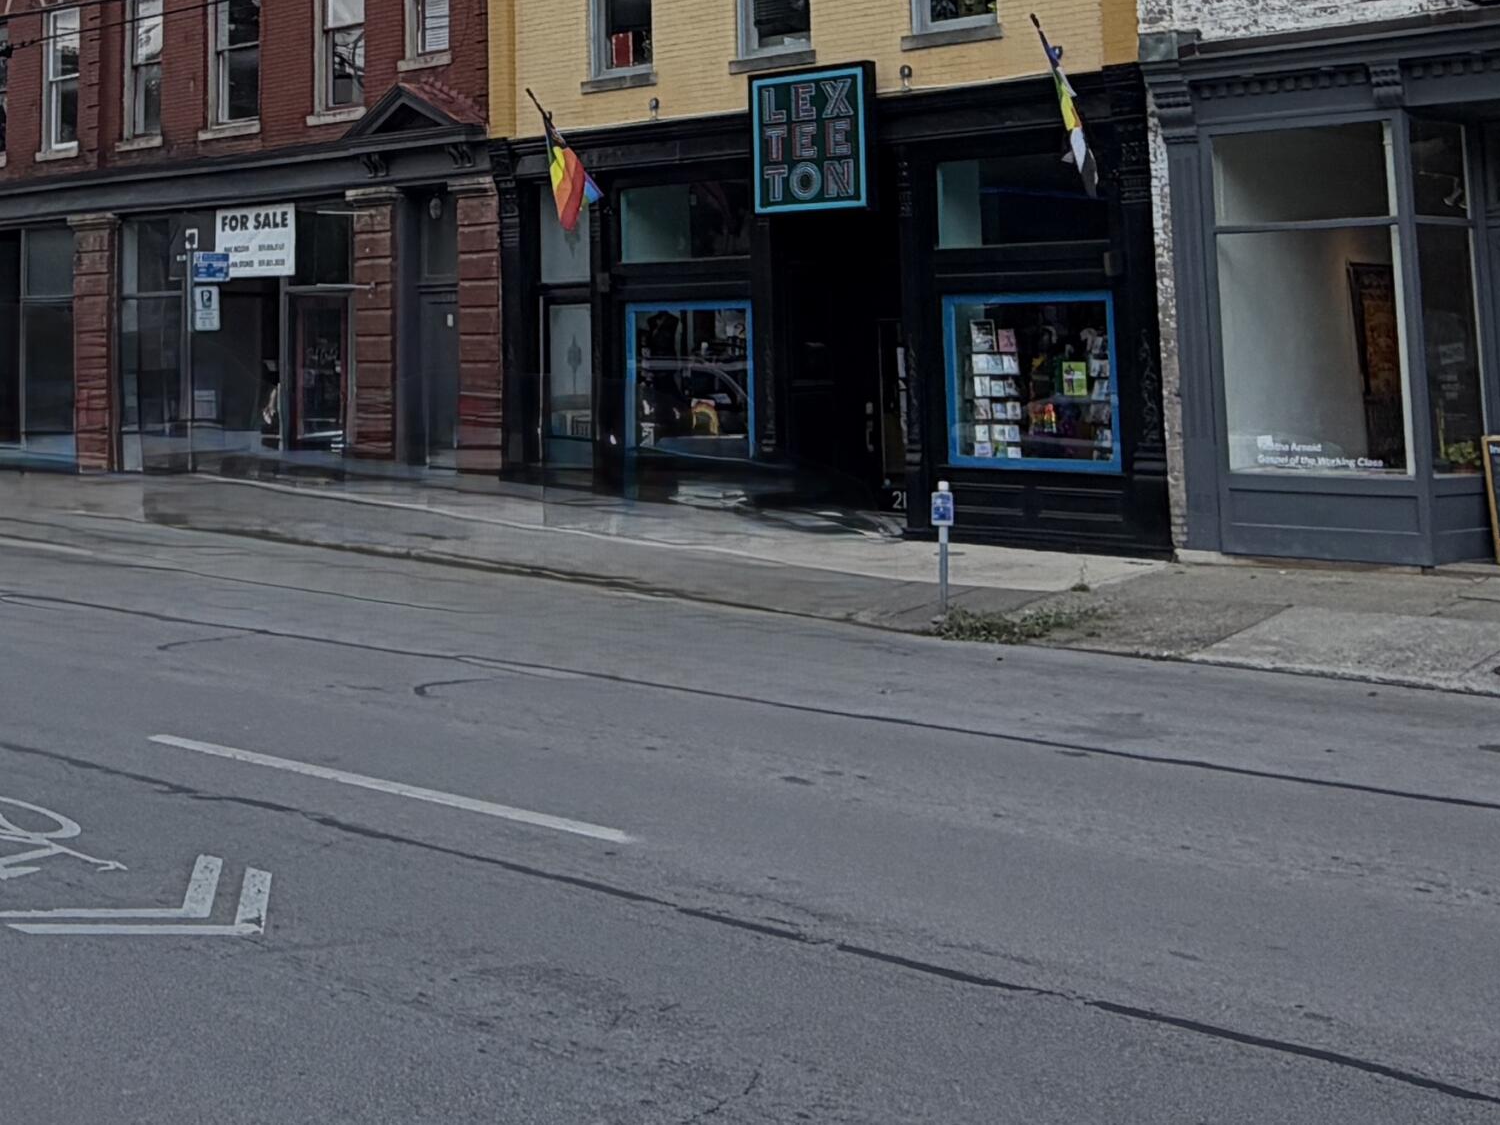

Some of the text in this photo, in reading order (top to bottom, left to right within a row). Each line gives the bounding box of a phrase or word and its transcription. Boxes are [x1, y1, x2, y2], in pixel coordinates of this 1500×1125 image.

[761, 78, 854, 124] LEX
[763, 118, 851, 162] TEE
[763, 159, 854, 202] TON
[221, 211, 289, 232] FOR SALE
[1357, 457, 1383, 467] Class
